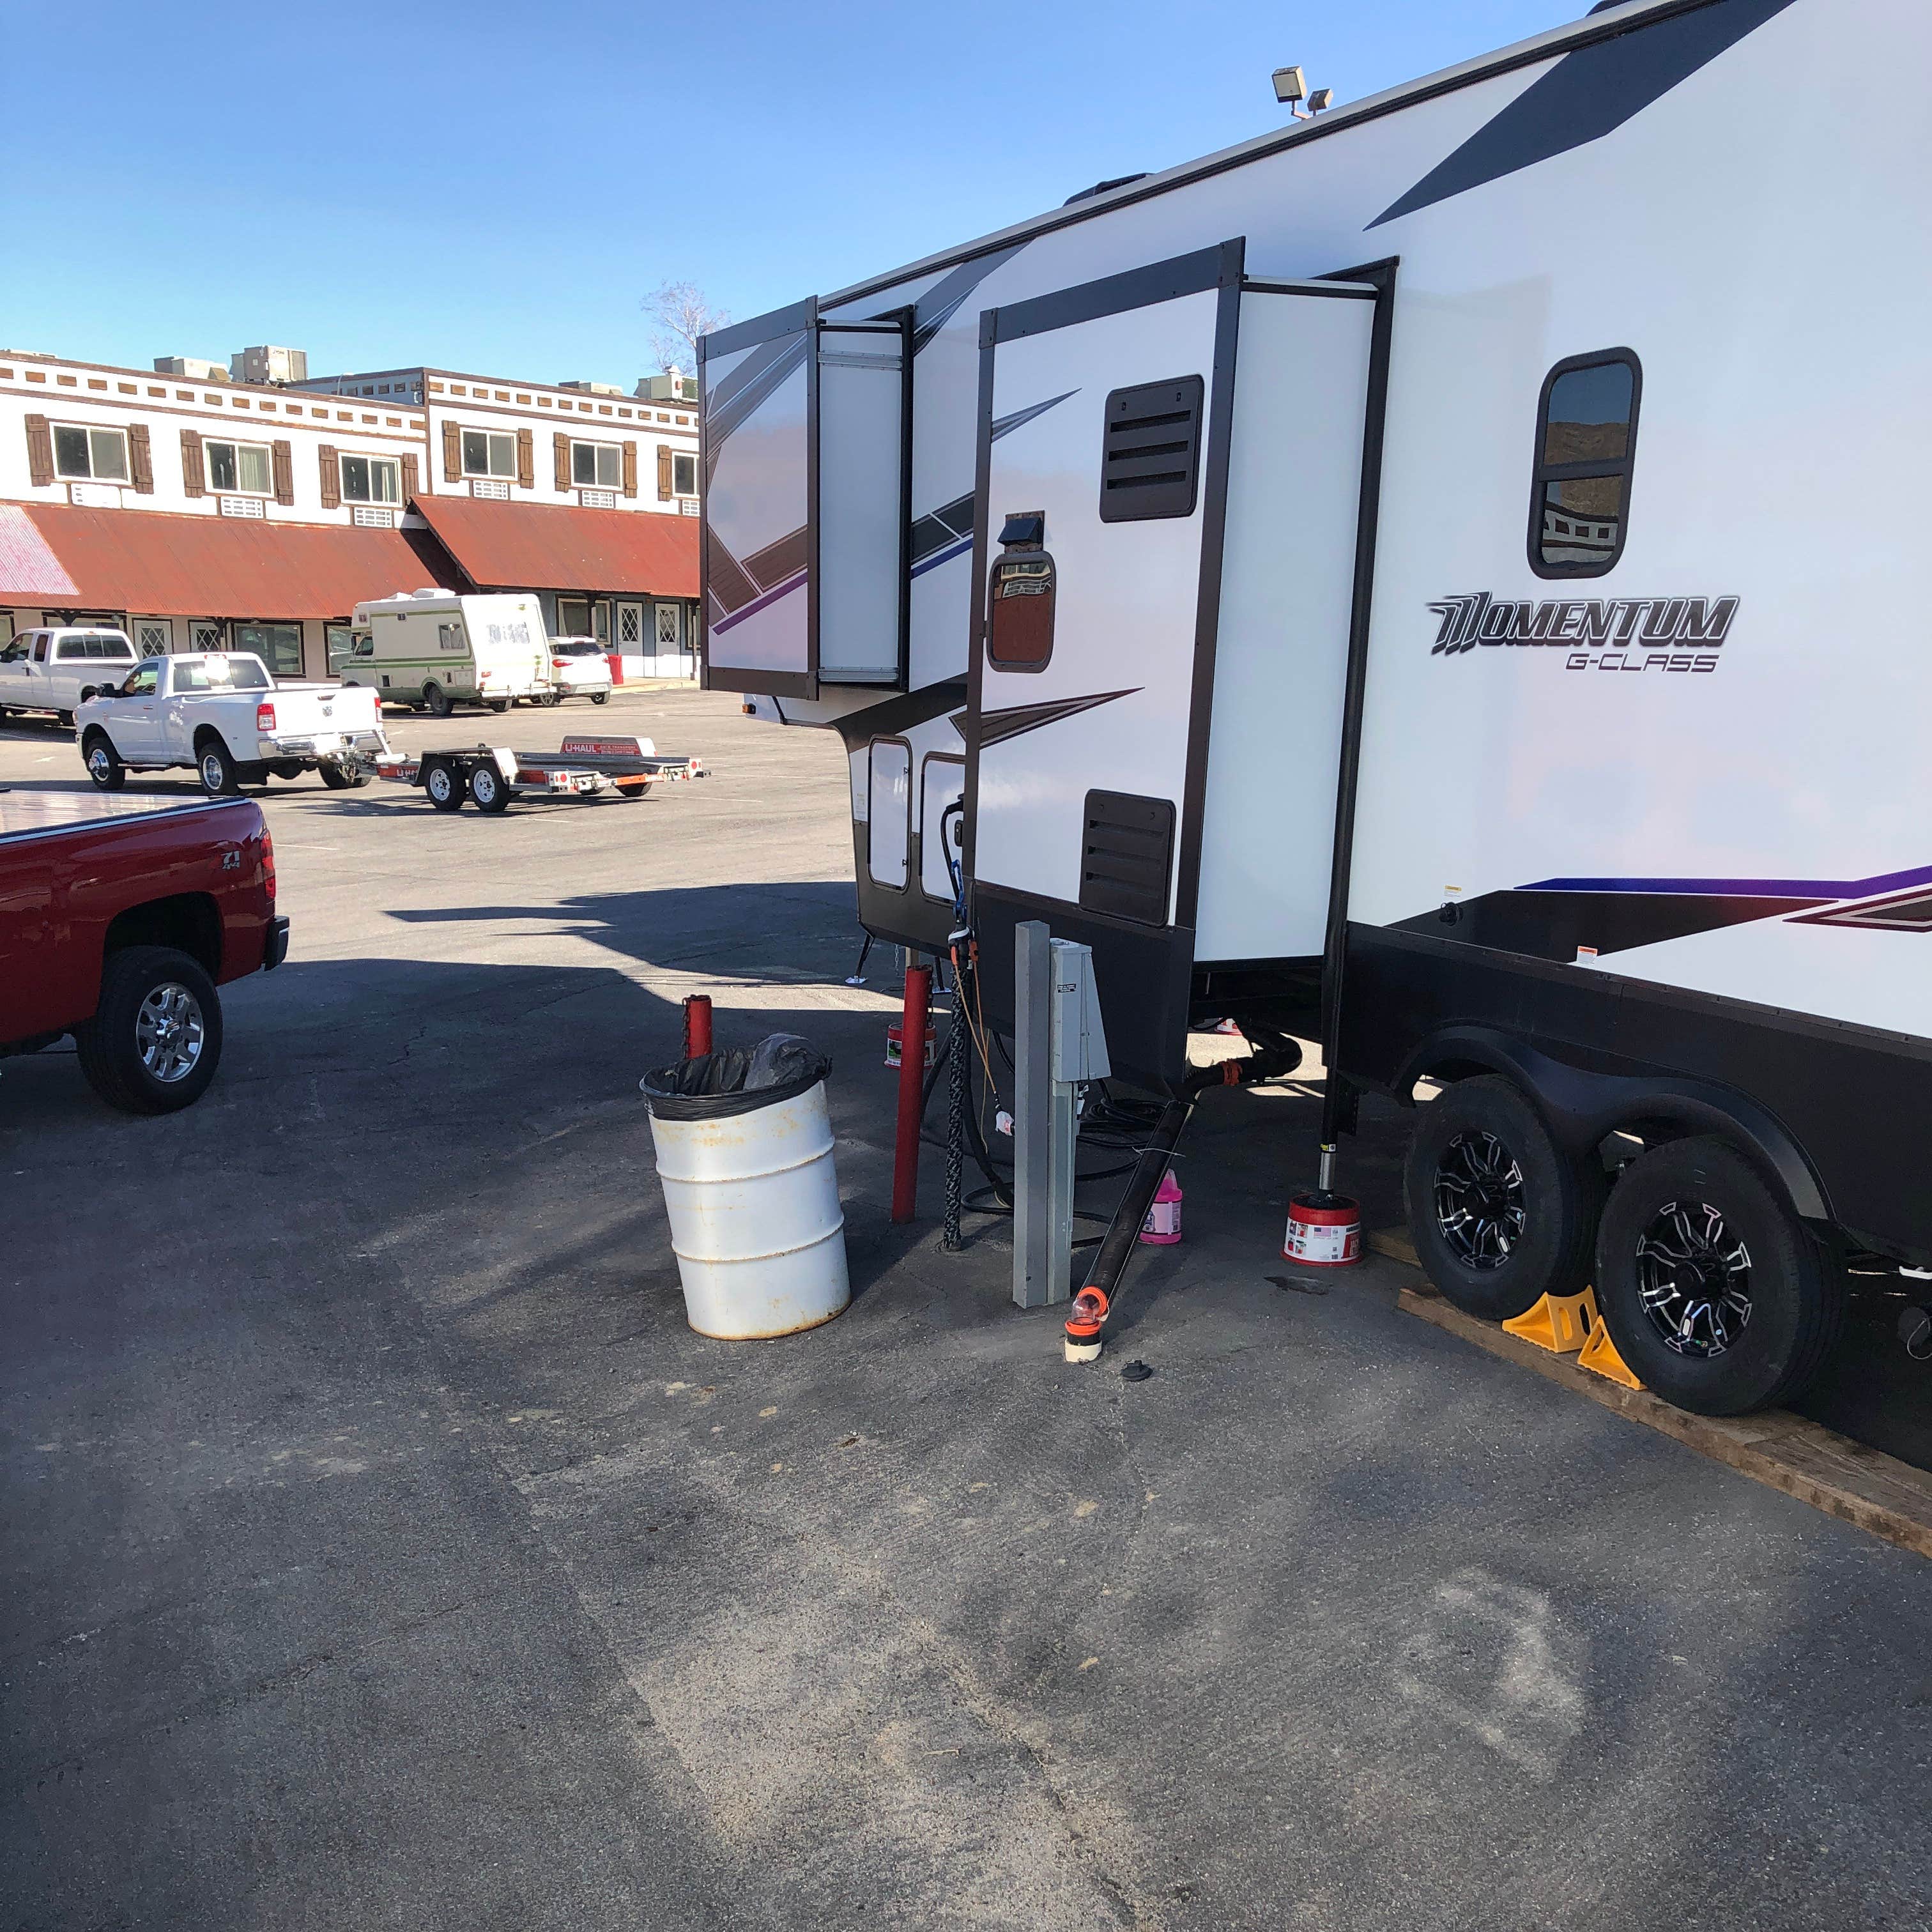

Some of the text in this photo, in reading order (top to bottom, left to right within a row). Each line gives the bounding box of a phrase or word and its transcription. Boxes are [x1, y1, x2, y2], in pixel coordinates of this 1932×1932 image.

[1425, 590, 1740, 656] MOMENTUM
[1565, 653, 1720, 673] G-CLASS
[565, 744, 597, 753] U-HAUL
